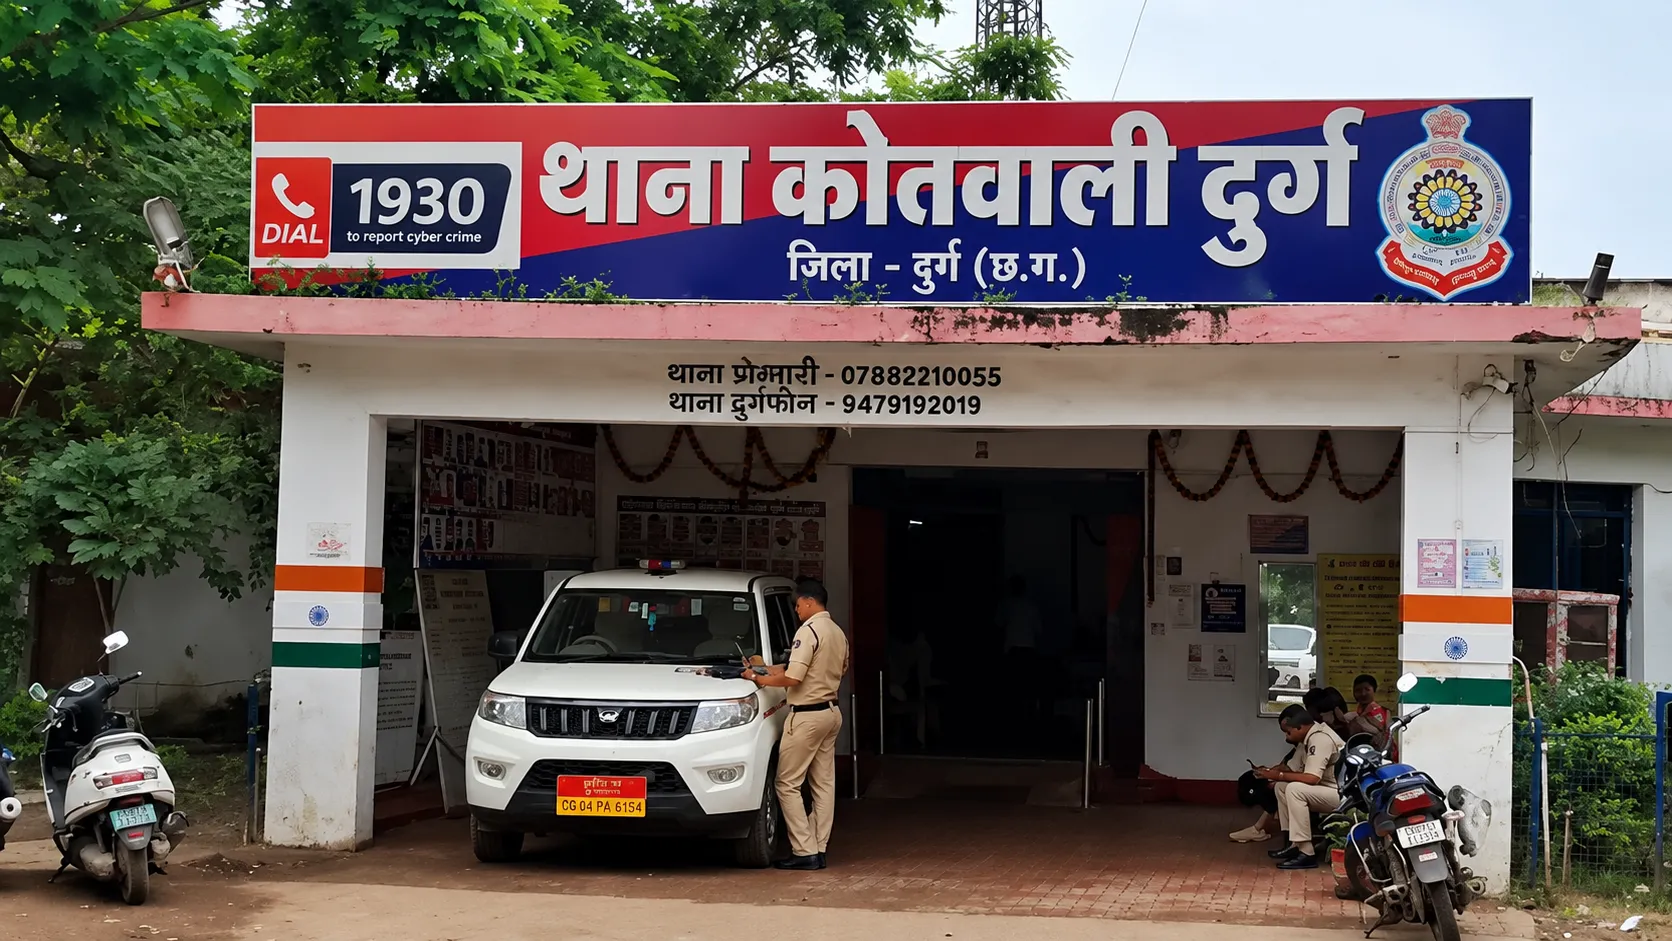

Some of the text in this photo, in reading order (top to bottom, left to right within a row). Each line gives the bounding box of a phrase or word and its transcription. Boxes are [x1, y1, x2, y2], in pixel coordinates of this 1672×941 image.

[539, 141, 751, 225] थाना
[769, 109, 1177, 227] कोतवाली
[1197, 106, 1366, 268] दुर्ग
[349, 177, 486, 226] 1930
[261, 223, 324, 244] DIAL
[346, 229, 482, 246] to report cyber crime
[787, 238, 873, 282] जिला
[911, 237, 962, 296] दुर्ग
[973, 246, 1087, 290] (छ.ग.)
[668, 363, 725, 384] थाना
[841, 365, 1002, 388] 07882210055
[668, 392, 725, 413] थाना
[842, 393, 981, 416] 9479192019
[562, 800, 642, 813] CG 04 PA 6154
